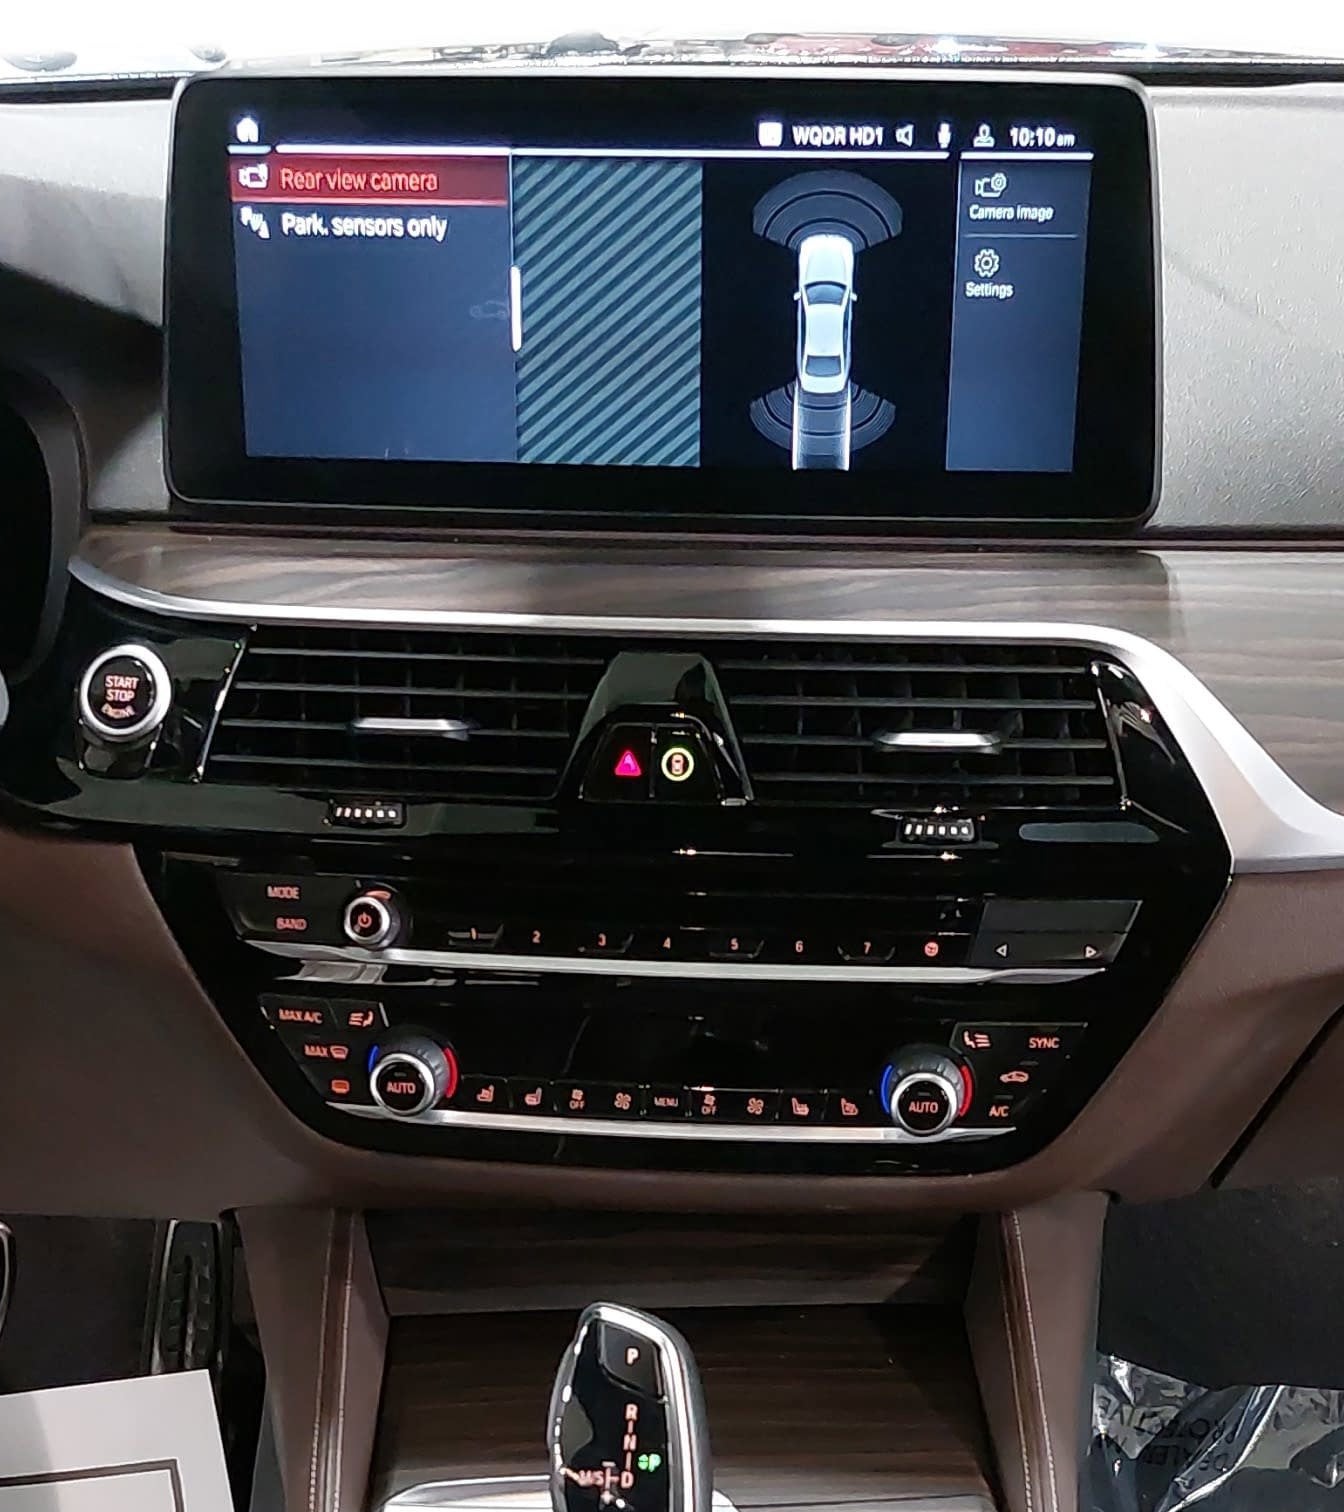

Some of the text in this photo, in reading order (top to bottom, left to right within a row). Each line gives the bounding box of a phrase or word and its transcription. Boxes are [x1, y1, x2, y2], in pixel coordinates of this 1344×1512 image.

[792, 125, 884, 147] WQDR HD1
[280, 167, 439, 193] Rear view camera
[968, 204, 1055, 222] Camera image
[281, 211, 449, 243] Park. sensors only
[965, 281, 1015, 300] Settings
[105, 675, 140, 690] START
[105, 689, 136, 703] STOP
[267, 885, 300, 900] MODE
[276, 916, 308, 931] BAND
[532, 931, 542, 944] 2
[598, 934, 607, 947] 3
[662, 936, 672, 949] 4
[730, 938, 739, 951] 5
[795, 940, 804, 953] 6
[863, 942, 872, 955] 7
[1028, 1036, 1060, 1049] SYNC
[304, 1044, 329, 1058] MAX
[386, 1081, 416, 1094] AUTO
[568, 1099, 585, 1110] OFF
[653, 1096, 679, 1108] MENU
[908, 1101, 939, 1114] AUTO
[988, 1105, 1010, 1118] A/C
[626, 1347, 639, 1365] P
[625, 1403, 638, 1421] R
[623, 1433, 637, 1451] N
[620, 1469, 635, 1489] D
